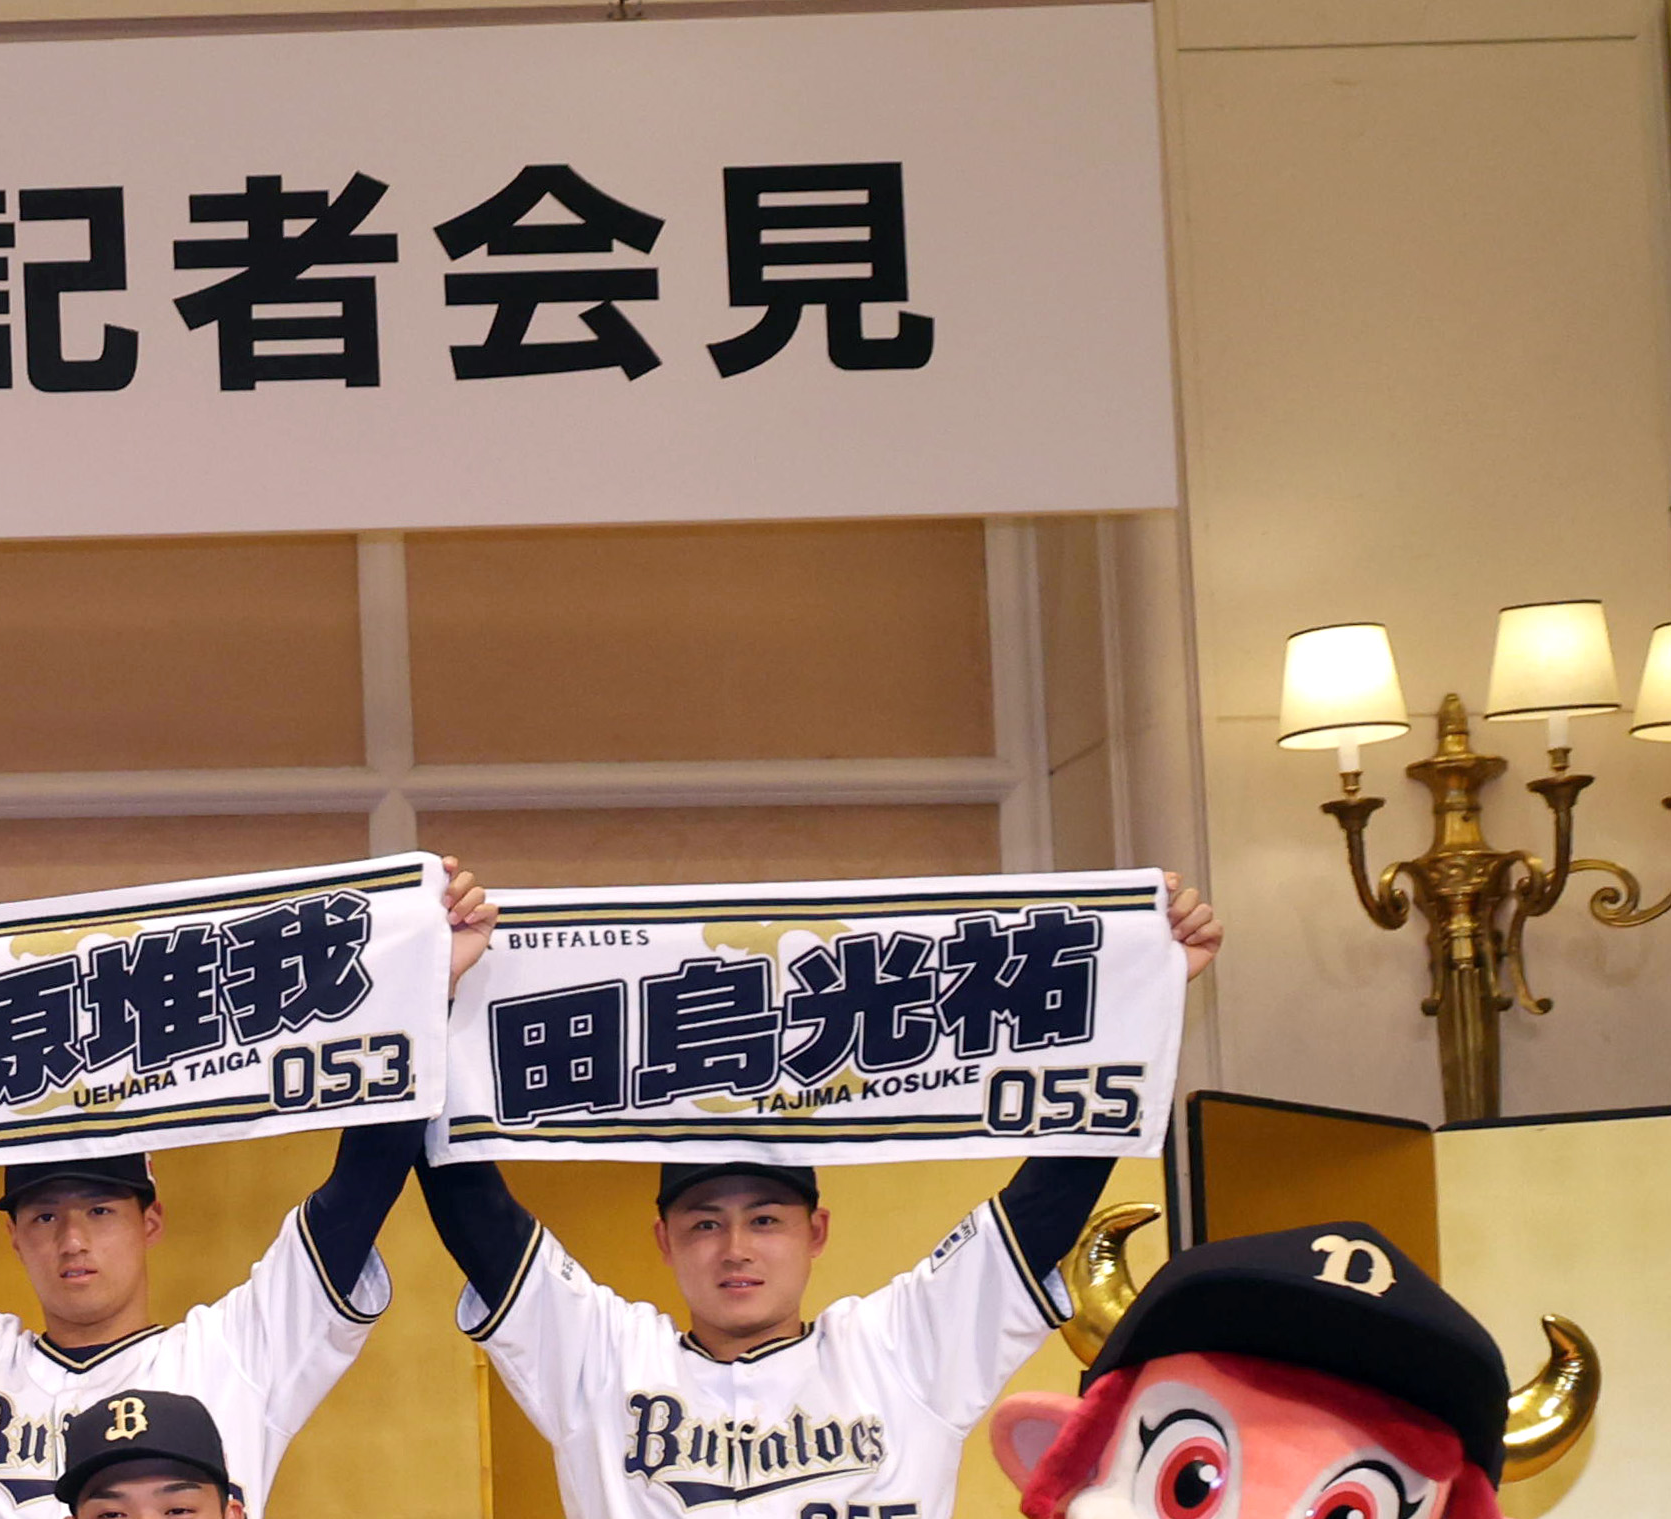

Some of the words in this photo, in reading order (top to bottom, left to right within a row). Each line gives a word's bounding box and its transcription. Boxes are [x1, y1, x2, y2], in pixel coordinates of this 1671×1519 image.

[509, 929, 650, 950] BUFFALOES
[488, 903, 1103, 1129] 田島光祐
[73, 1070, 178, 1109] UEHARA
[185, 1049, 263, 1084] TAIGA
[269, 1031, 416, 1112] 053
[752, 1082, 853, 1115] TAJIMA
[861, 1065, 981, 1101] KOSUKE
[983, 1062, 1145, 1135] 055
[104, 1396, 150, 1442] B
[623, 1391, 888, 1488] Buffaloes
